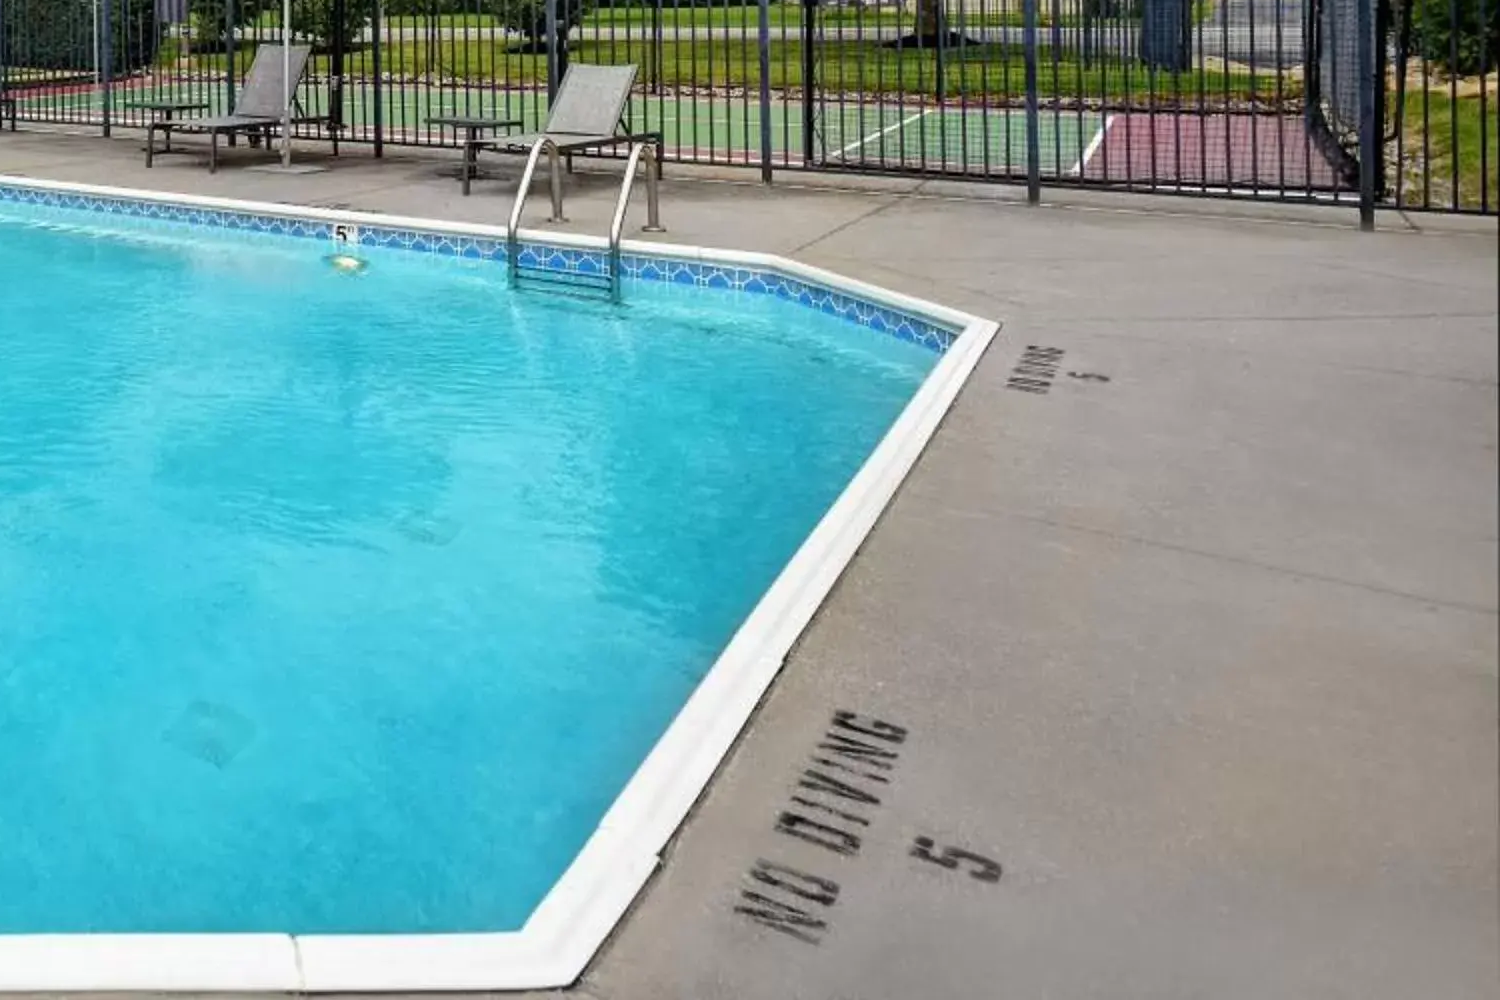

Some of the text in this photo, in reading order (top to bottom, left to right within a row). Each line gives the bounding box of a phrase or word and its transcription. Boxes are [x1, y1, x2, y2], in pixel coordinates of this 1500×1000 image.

[336, 225, 347, 242] 5
[734, 710, 908, 946] NO DIVING
[909, 835, 1003, 883] 5
